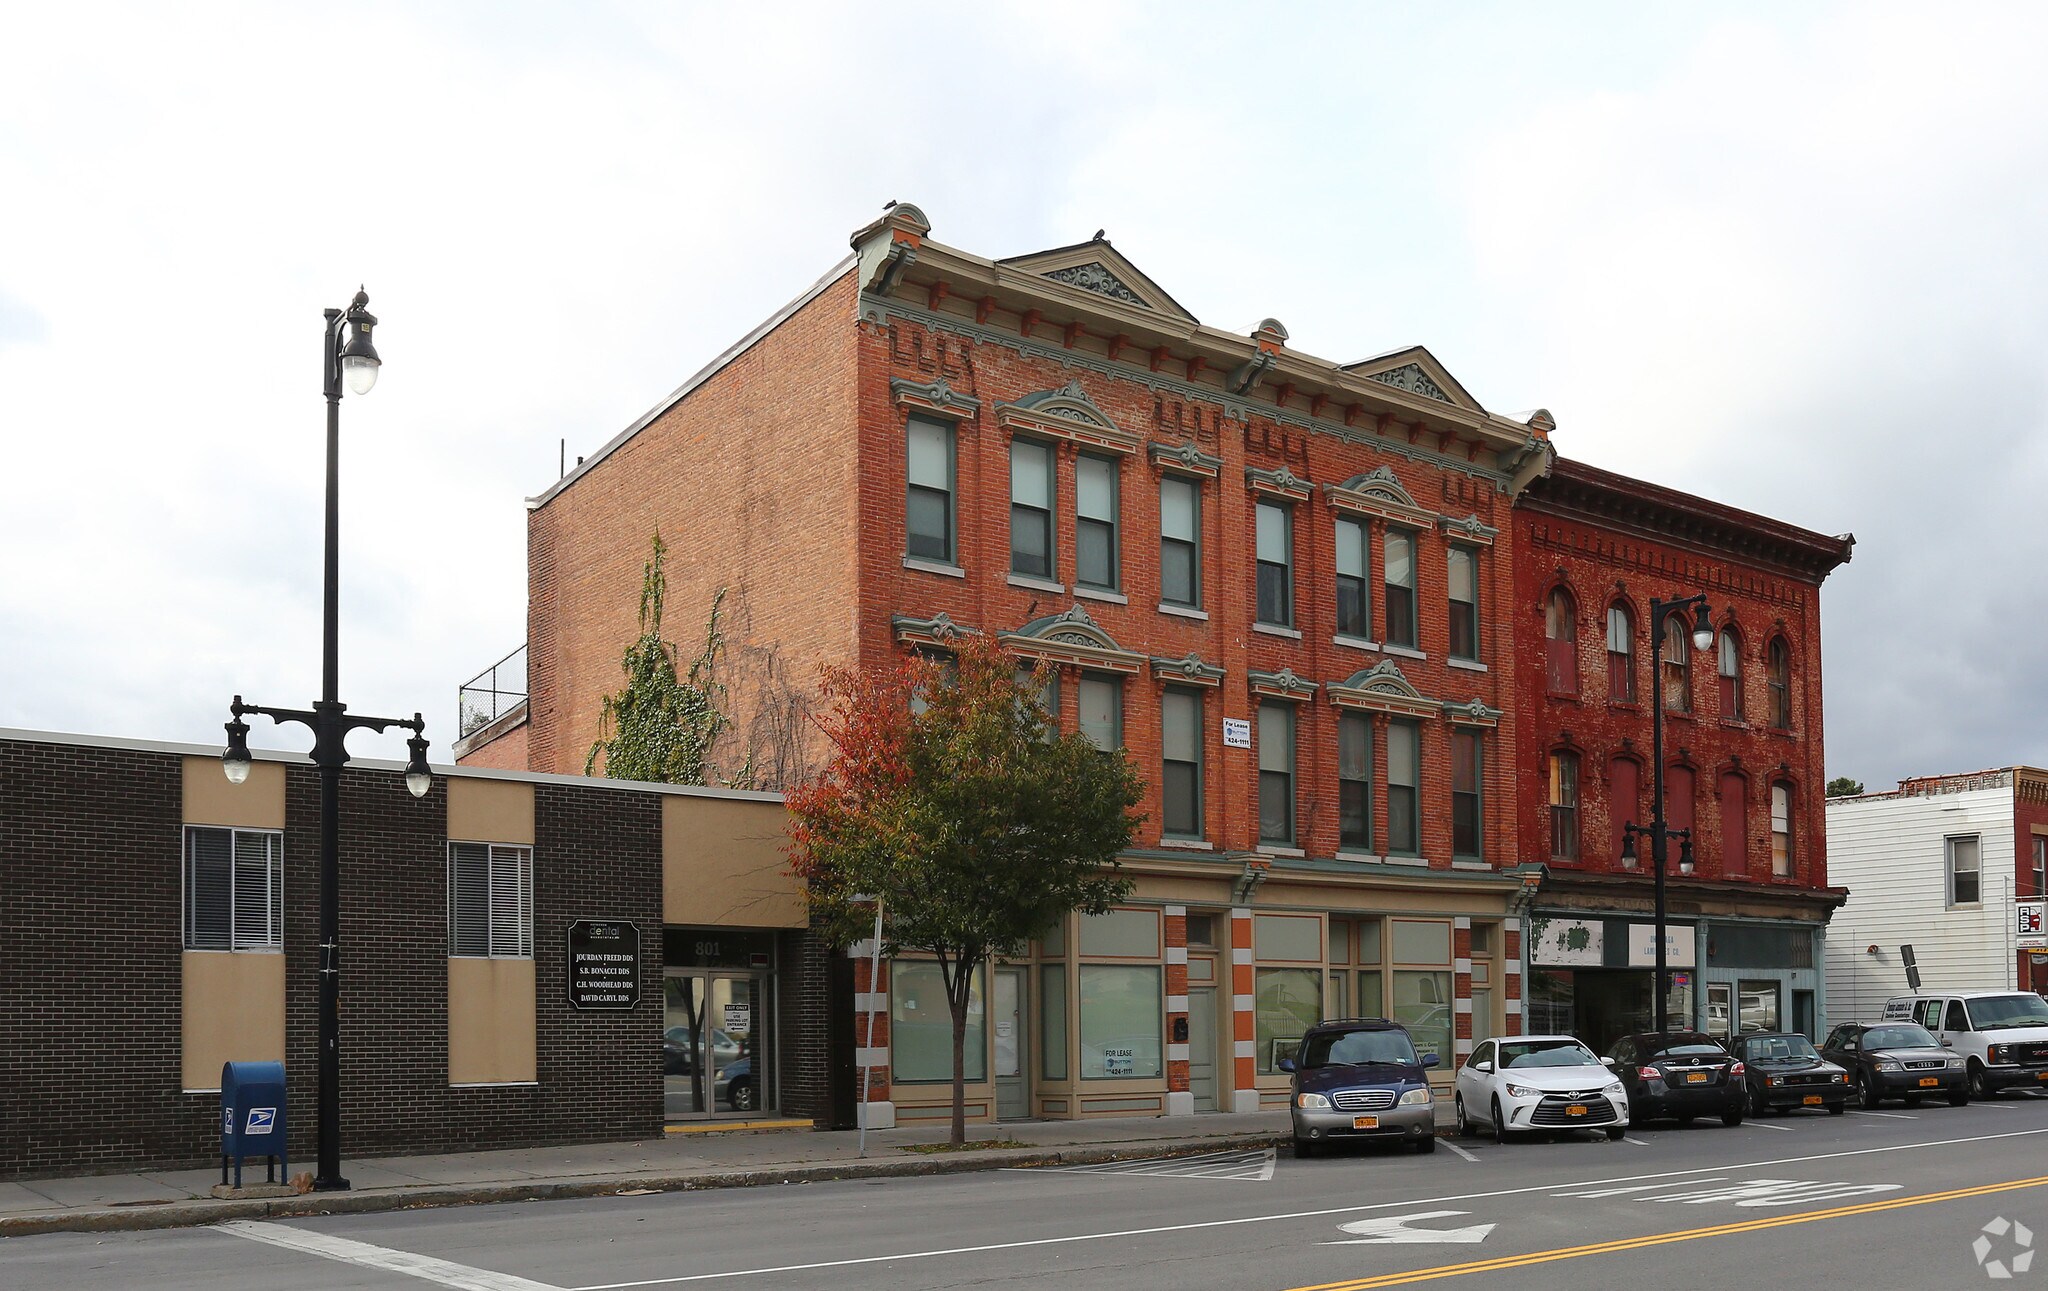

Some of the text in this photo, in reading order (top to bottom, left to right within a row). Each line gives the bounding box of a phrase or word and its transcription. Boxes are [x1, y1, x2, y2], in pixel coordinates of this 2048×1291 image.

[1228, 738, 1250, 746] 424-1111
[590, 926, 620, 936] dental
[695, 941, 721, 956] 801
[576, 953, 603, 962] JOURDAN
[580, 967, 630, 975] S.B. BONACCI DDS
[581, 994, 630, 1002] DAVID CARYL DDS
